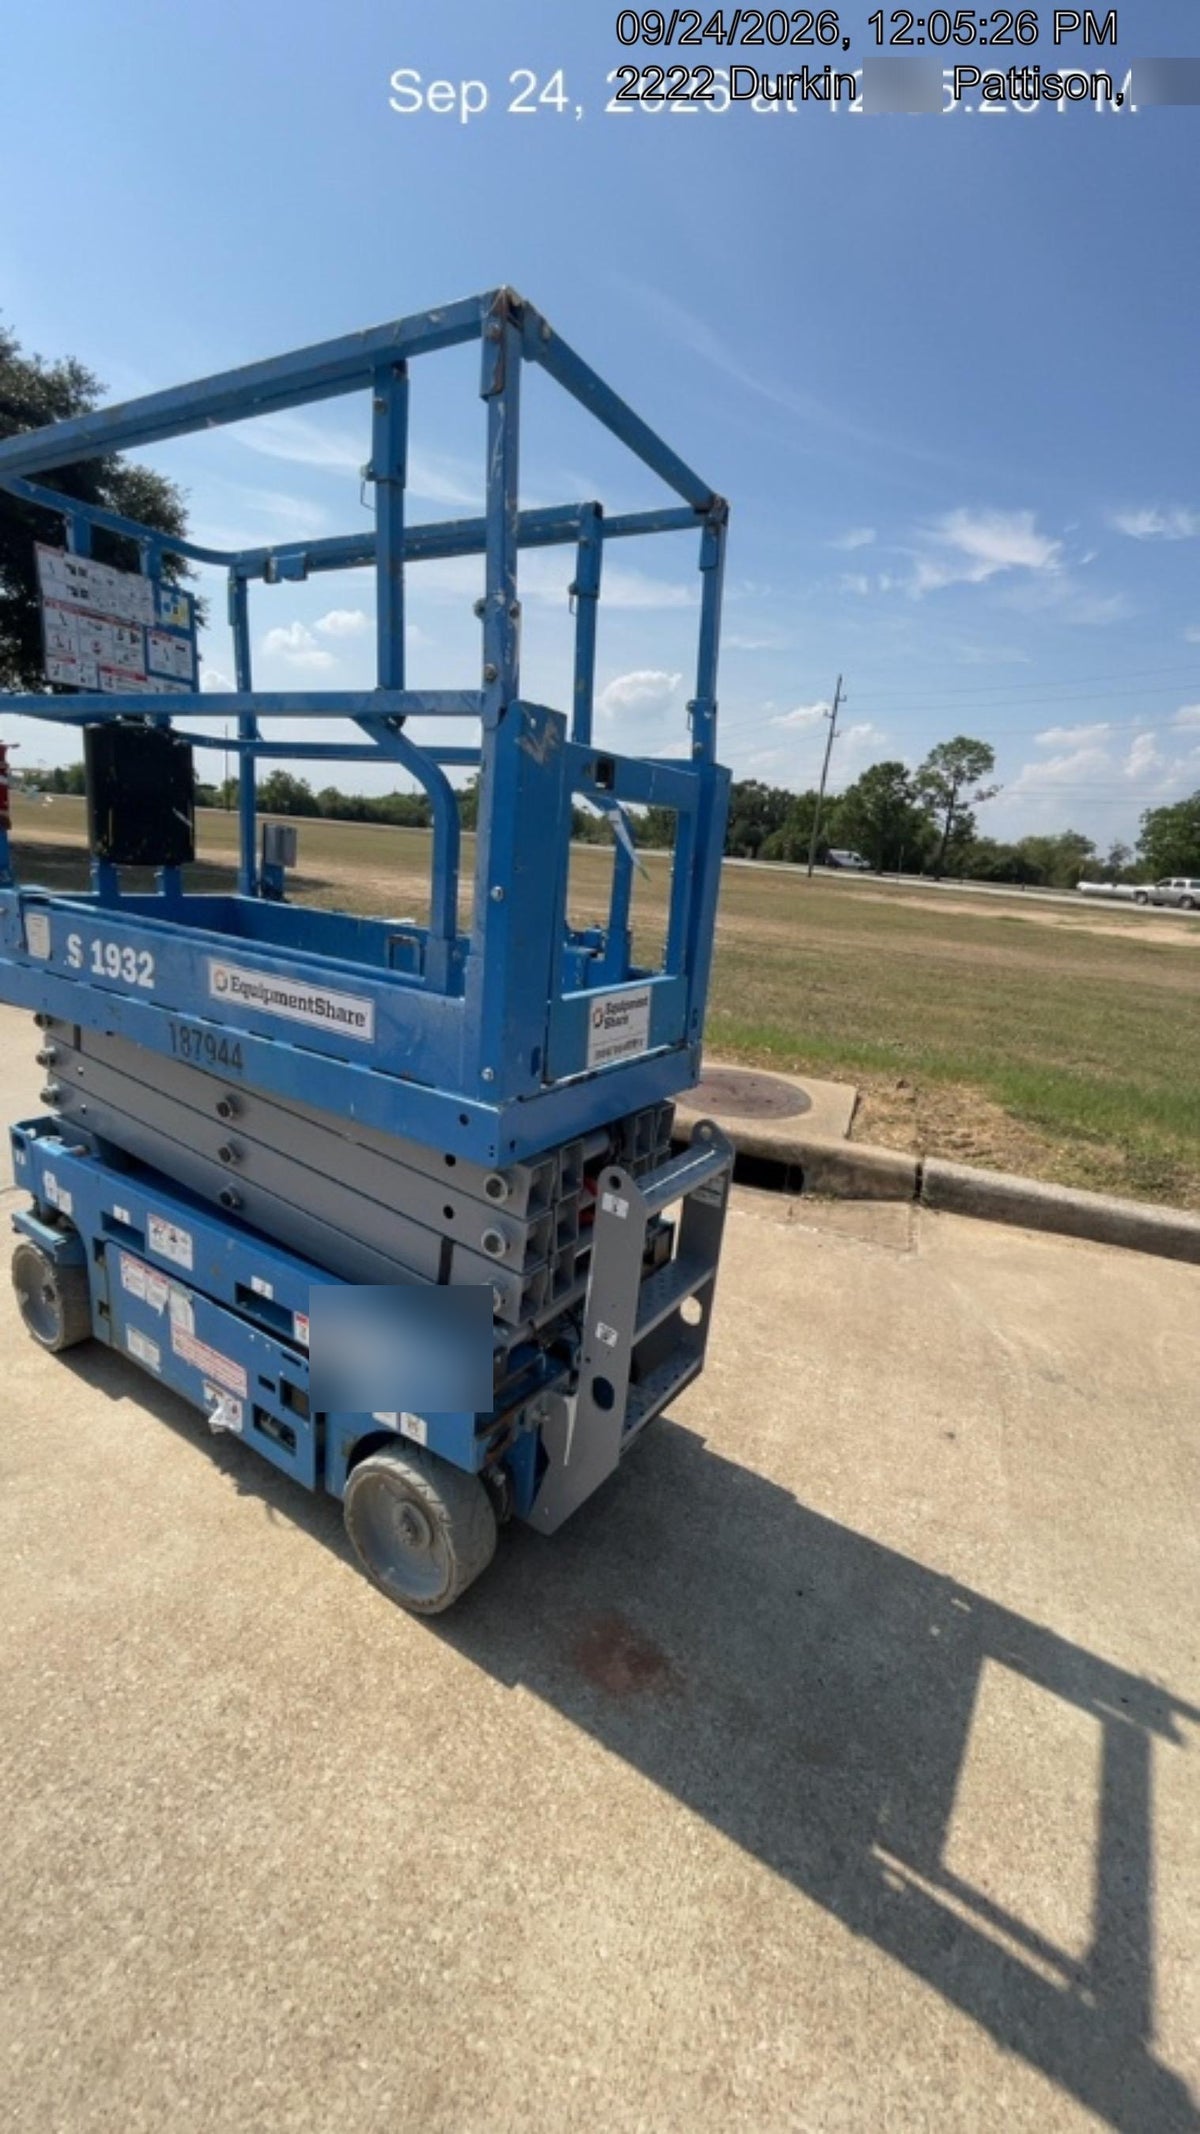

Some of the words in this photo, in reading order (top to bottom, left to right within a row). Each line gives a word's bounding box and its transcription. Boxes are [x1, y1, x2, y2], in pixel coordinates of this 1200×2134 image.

[91, 938, 156, 990] 1932
[229, 975, 367, 1028] EquipmentShare
[168, 1021, 245, 1071] 187944
